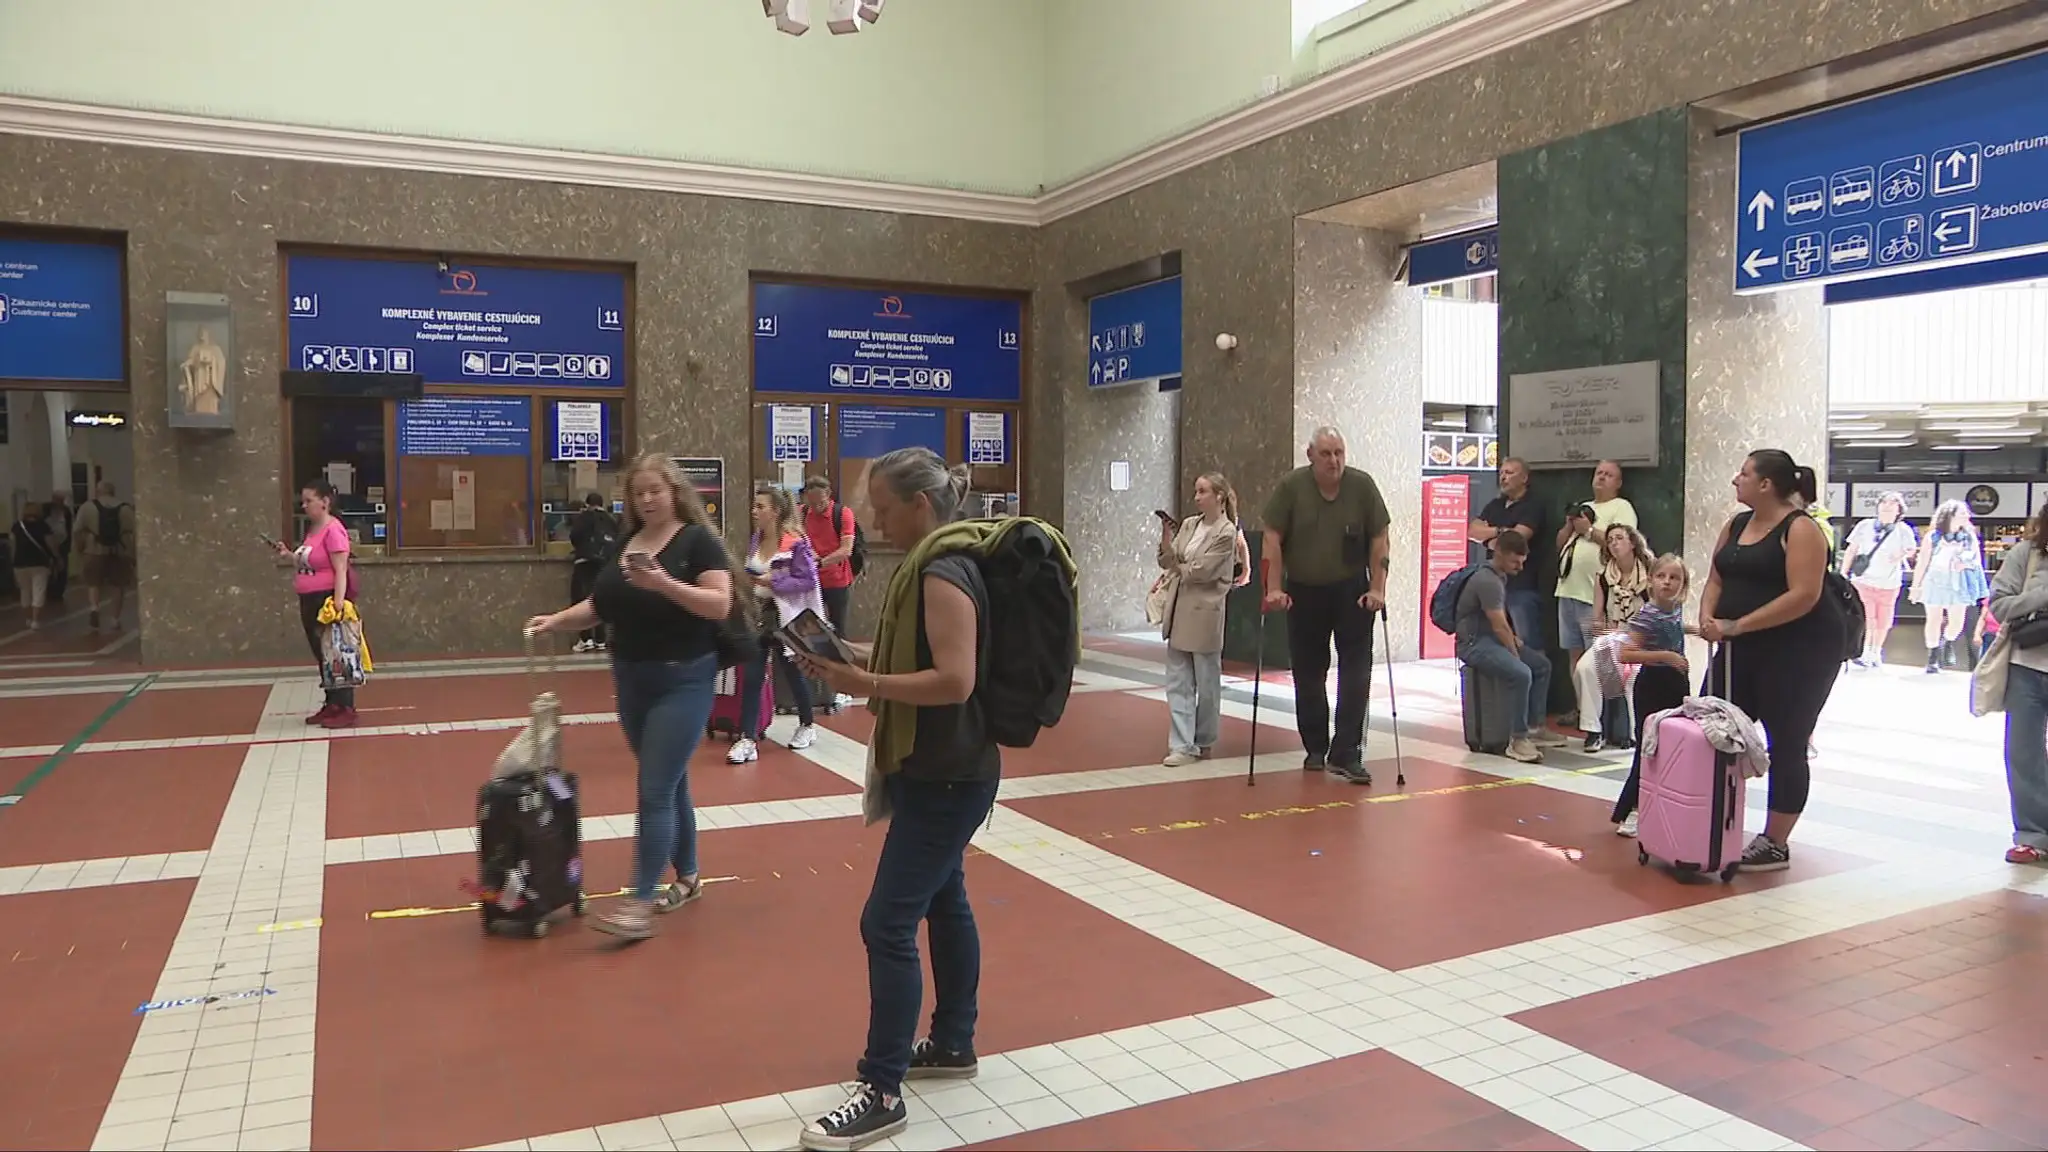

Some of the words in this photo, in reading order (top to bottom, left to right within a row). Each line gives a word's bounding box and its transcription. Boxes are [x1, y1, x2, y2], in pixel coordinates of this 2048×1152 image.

[1984, 136, 2048, 157] Centrum
[1981, 198, 2048, 220] Žabotova
[294, 296, 312, 311] 10
[11, 307, 51, 317] Customer
[52, 310, 77, 318] center
[381, 307, 435, 320] KOMPLEXNÉ
[436, 310, 483, 322] VYBAVENIE
[484, 311, 541, 325] CESTUJÚCICH
[604, 310, 620, 325] 11
[422, 322, 454, 332] Complex
[455, 323, 476, 332] ticket
[477, 325, 503, 333] service
[758, 317, 772, 331] 12
[416, 332, 455, 342] Komplexer
[456, 333, 509, 343] Kundenservice
[827, 328, 870, 340] KOMPLEXNÉ
[871, 331, 909, 343] VYBAVENIE
[909, 332, 955, 345] CESTUJÚCICH
[1003, 331, 1016, 344] 13
[859, 341, 885, 350] Complex
[885, 342, 903, 350] ticket
[903, 344, 924, 352] service
[886, 351, 929, 361] Kundenservice
